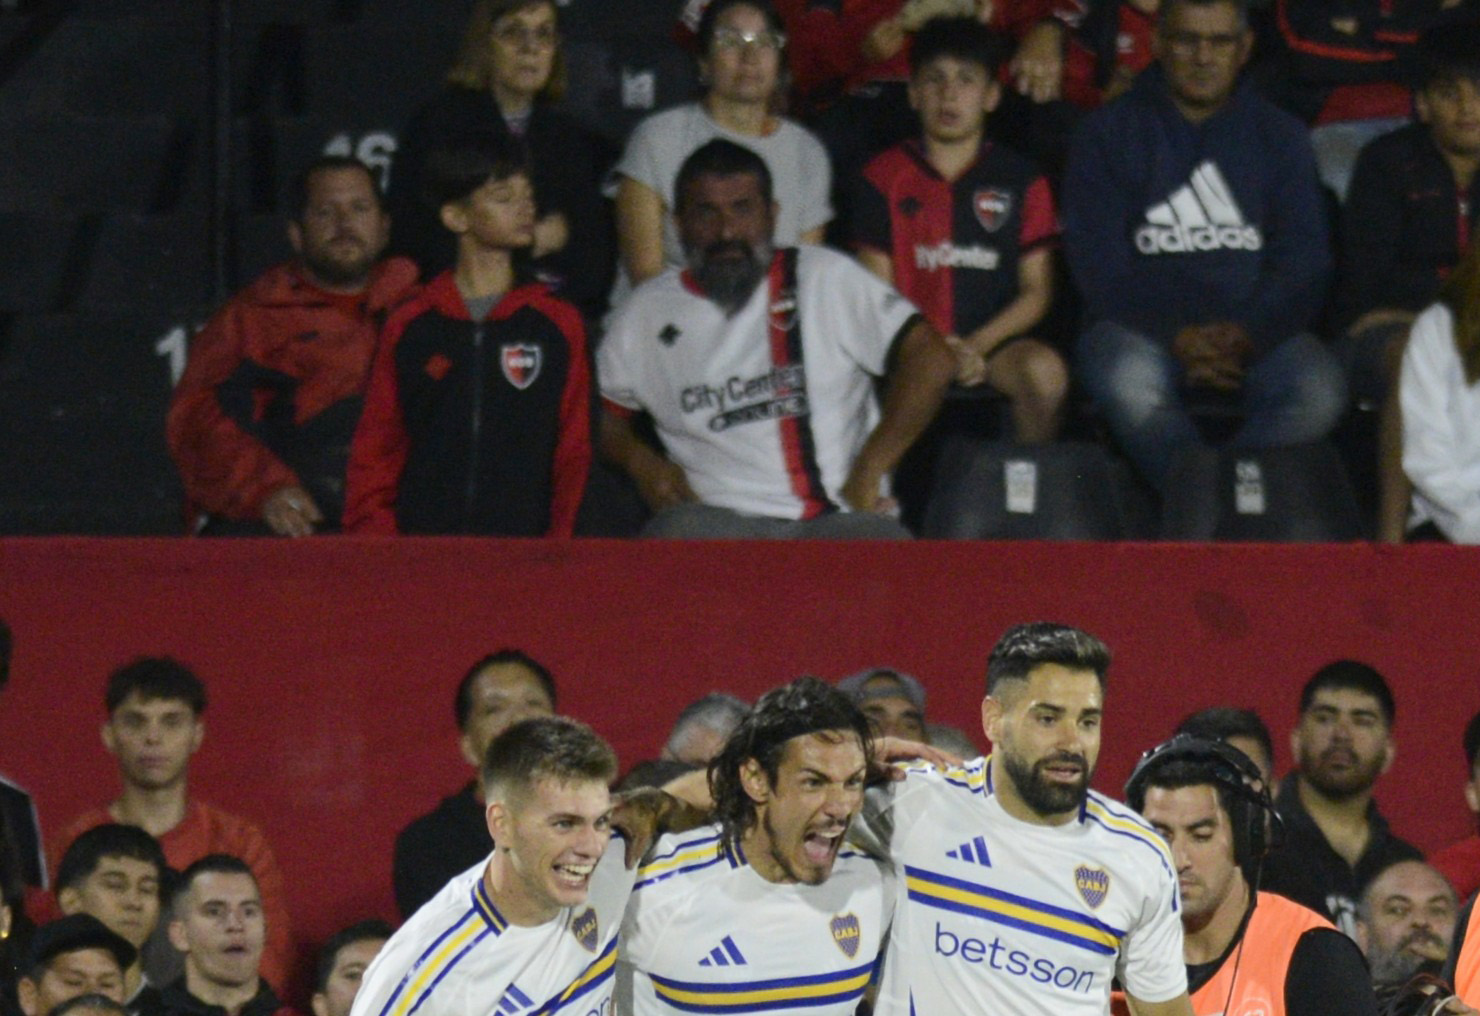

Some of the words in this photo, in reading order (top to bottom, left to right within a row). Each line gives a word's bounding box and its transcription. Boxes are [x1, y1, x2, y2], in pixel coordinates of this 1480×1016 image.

[1136, 223, 1263, 255] adidas
[1078, 880, 1106, 893] CABJ
[576, 914, 596, 939] CABJ
[835, 927, 858, 939] CABJ
[935, 921, 1094, 994] betsson
